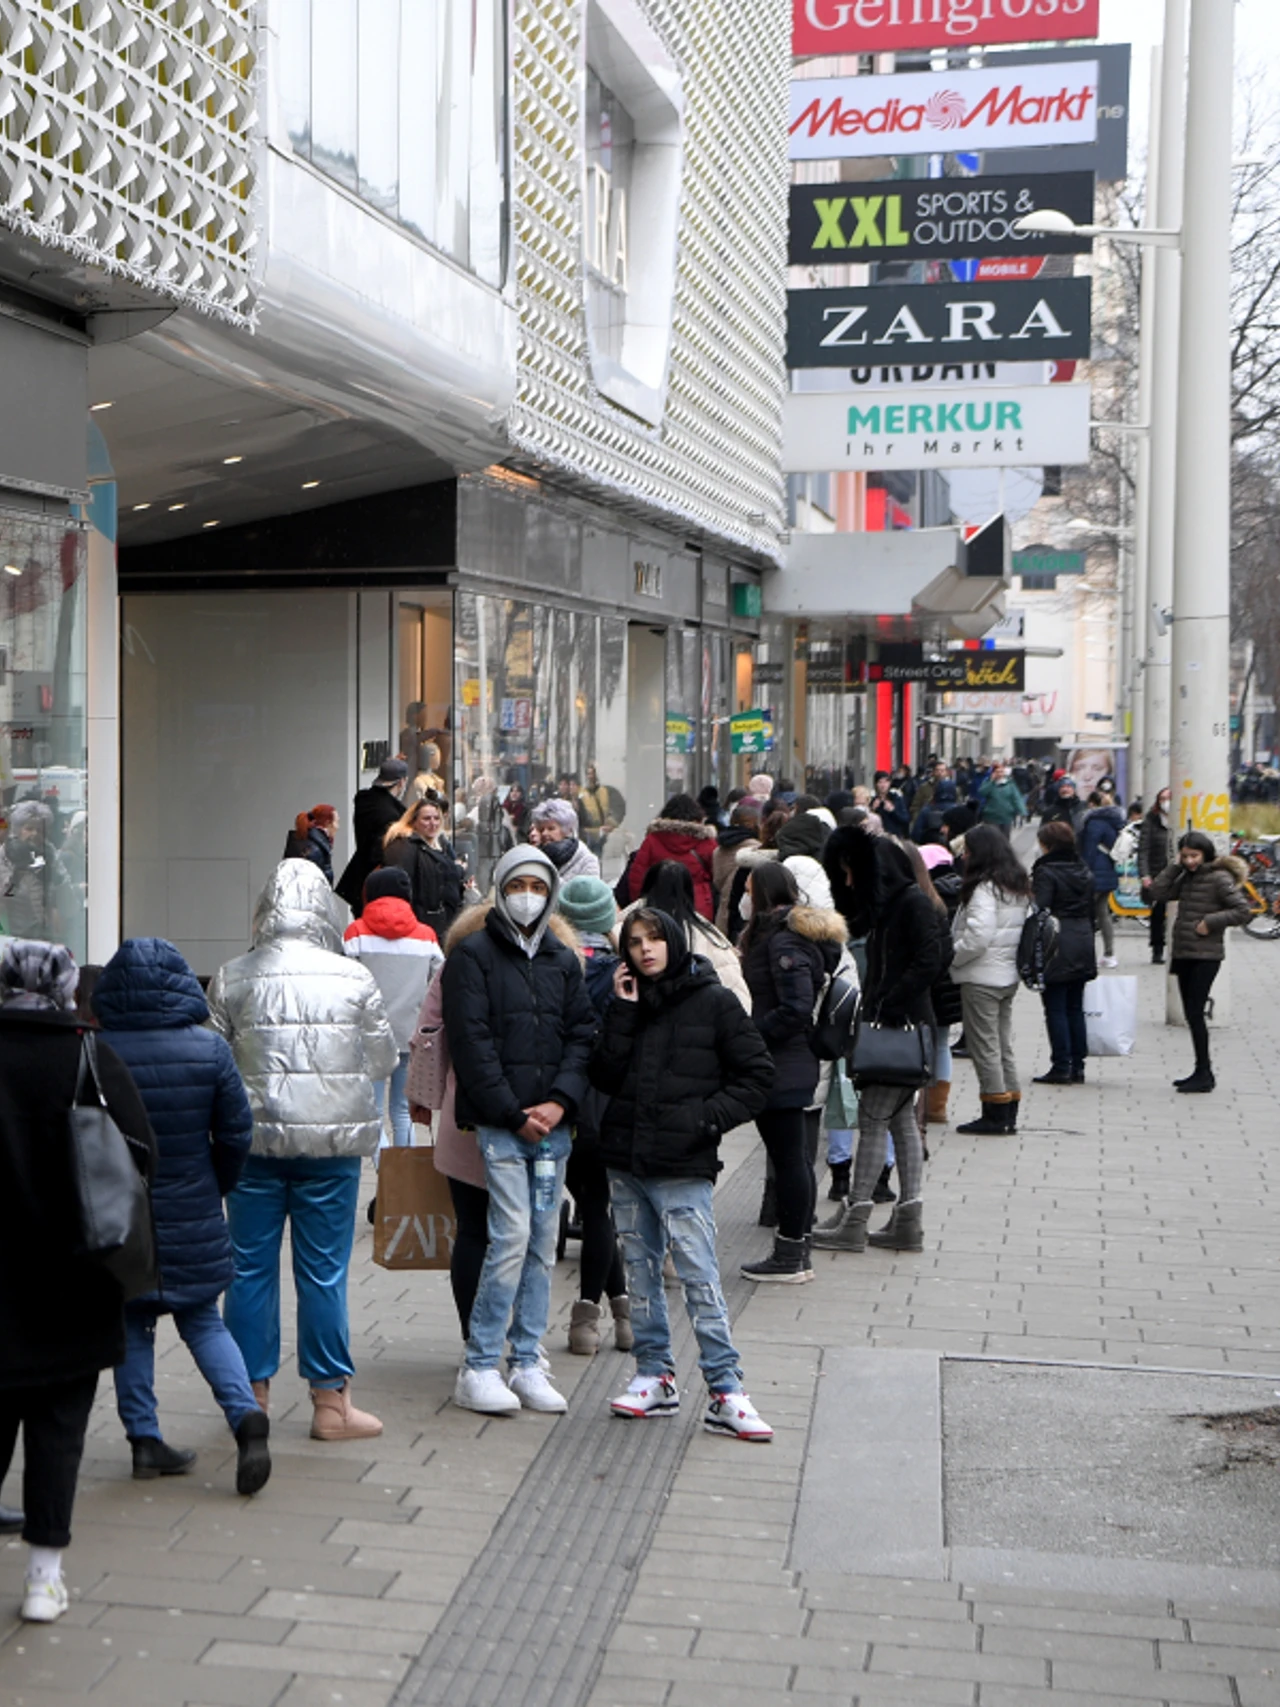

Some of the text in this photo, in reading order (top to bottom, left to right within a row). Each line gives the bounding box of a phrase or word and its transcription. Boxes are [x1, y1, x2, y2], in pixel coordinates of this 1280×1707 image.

[788, 85, 1094, 138] Media Markt
[916, 188, 1035, 217] SPORTS &
[811, 195, 910, 249] XXL
[913, 218, 1046, 245] OUTDOO
[978, 263, 1029, 277] MOBILE
[819, 299, 1073, 347] ZARA
[847, 401, 1024, 436] MERKUR
[846, 437, 1024, 456] Ihr Markt
[883, 662, 964, 678] Street One
[383, 1213, 457, 1262] ZAR
